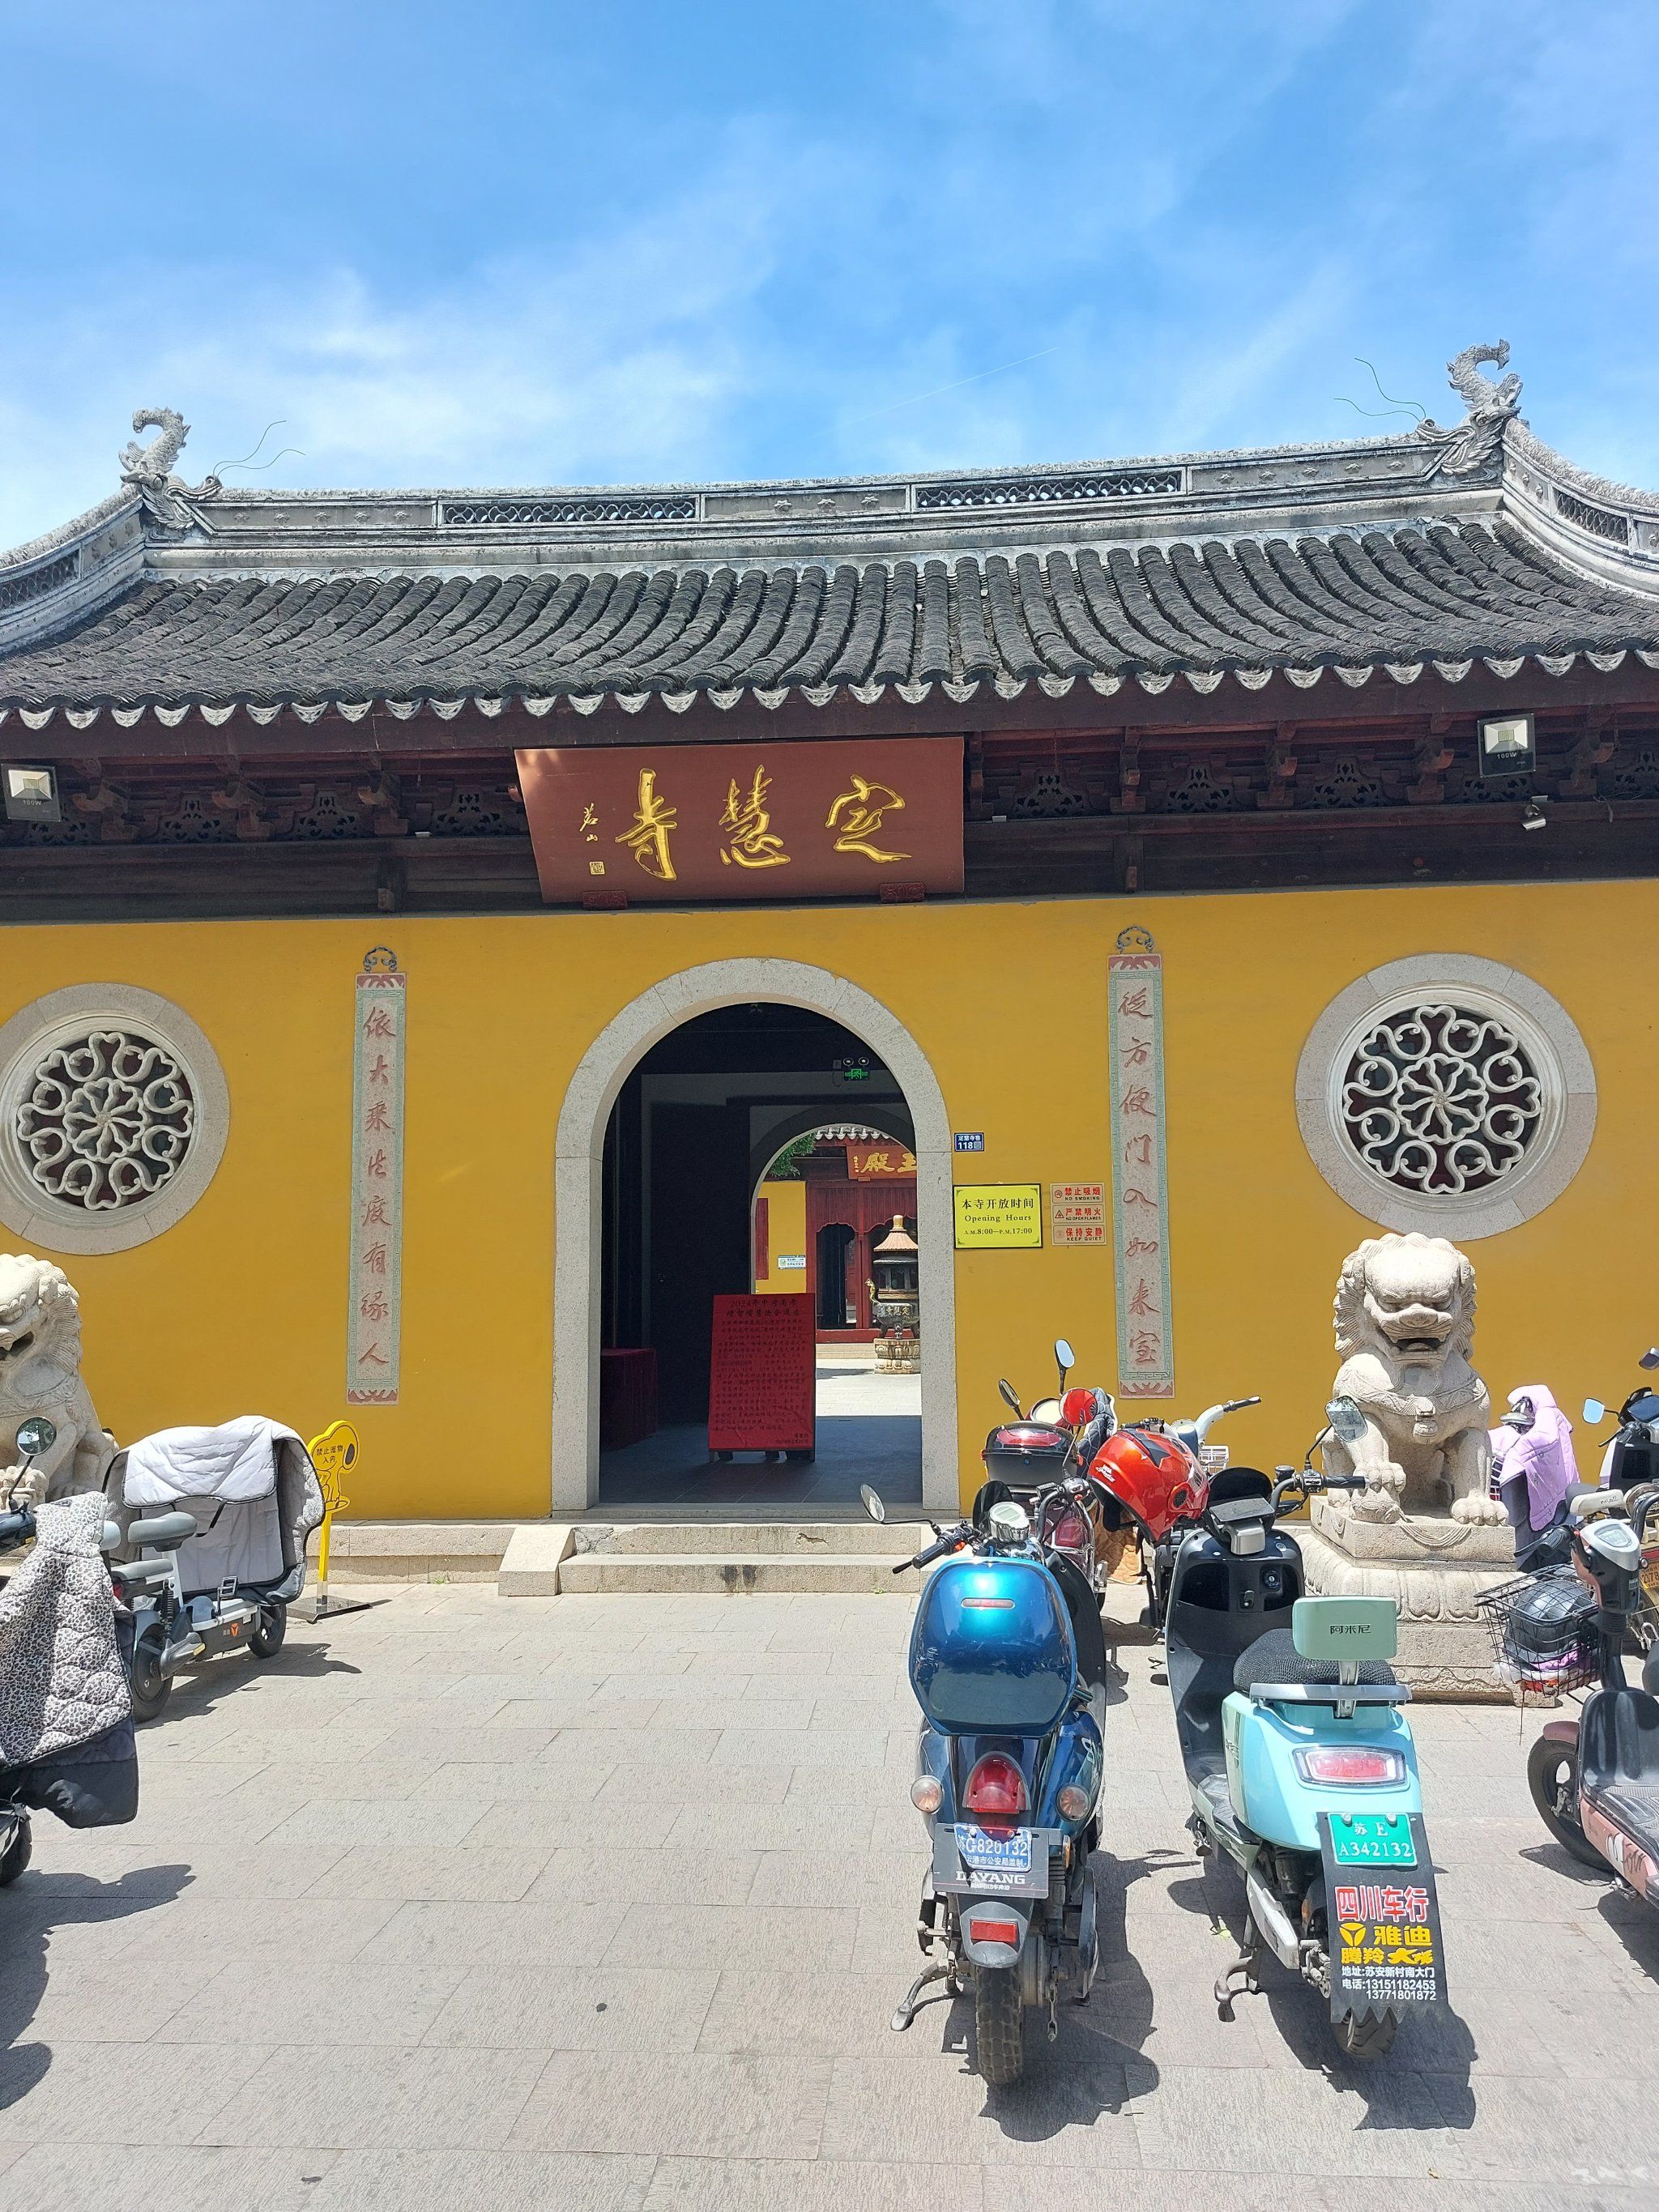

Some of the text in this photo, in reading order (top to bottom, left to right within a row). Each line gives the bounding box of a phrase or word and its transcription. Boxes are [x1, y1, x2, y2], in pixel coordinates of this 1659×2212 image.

[615, 764, 912, 881] 定慧寺
[957, 1141, 973, 1149] 118
[1064, 1187, 1100, 1196] 禁止吸烟
[962, 1198, 1034, 1210] 本寺开放时间
[964, 1214, 1000, 1223] Opening
[1065, 1208, 1101, 1217] 严禁明火
[1066, 1227, 1102, 1237] 保持安静
[316, 1444, 343, 1456] 禁止宠物
[322, 1455, 336, 1464] 入内
[1330, 1625, 1371, 1634] 阿米尼
[1353, 1822, 1389, 1836] 苏 E
[1338, 1841, 1413, 1857] A342132
[956, 1870, 1026, 1885] DAYANG
[1335, 1885, 1429, 1922] 四川车行
[1374, 1924, 1433, 1946] 雅迪
[1366, 1989, 1437, 2001] 13771801872
